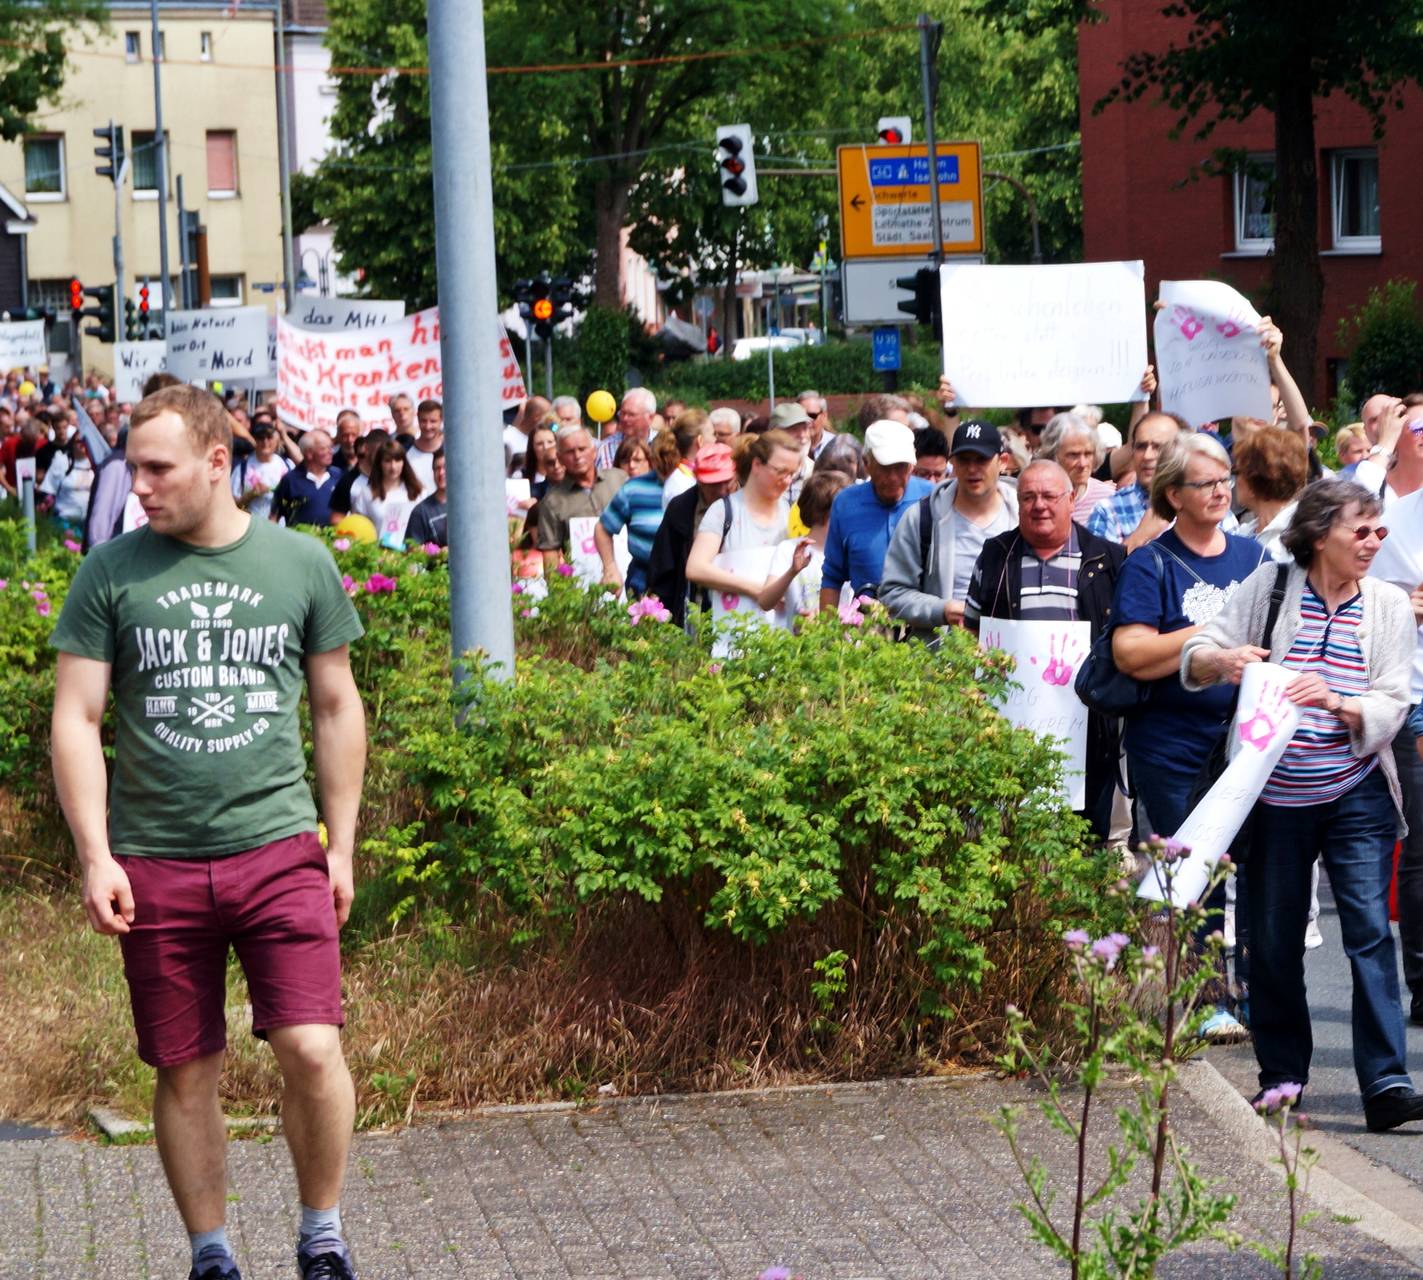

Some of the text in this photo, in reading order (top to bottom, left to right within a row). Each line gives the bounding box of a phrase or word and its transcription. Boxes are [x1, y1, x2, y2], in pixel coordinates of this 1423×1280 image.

[914, 172, 957, 183] Iseohn
[121, 351, 148, 368] Wir
[211, 348, 254, 371] Mord
[336, 338, 393, 361] man
[156, 582, 264, 610] TRADEMARK
[136, 623, 289, 672] JACK & JONES
[155, 665, 265, 689] CUSTOM BRAND
[247, 694, 277, 709] MADE
[154, 717, 270, 753] QUALITY SUPPLY CO
